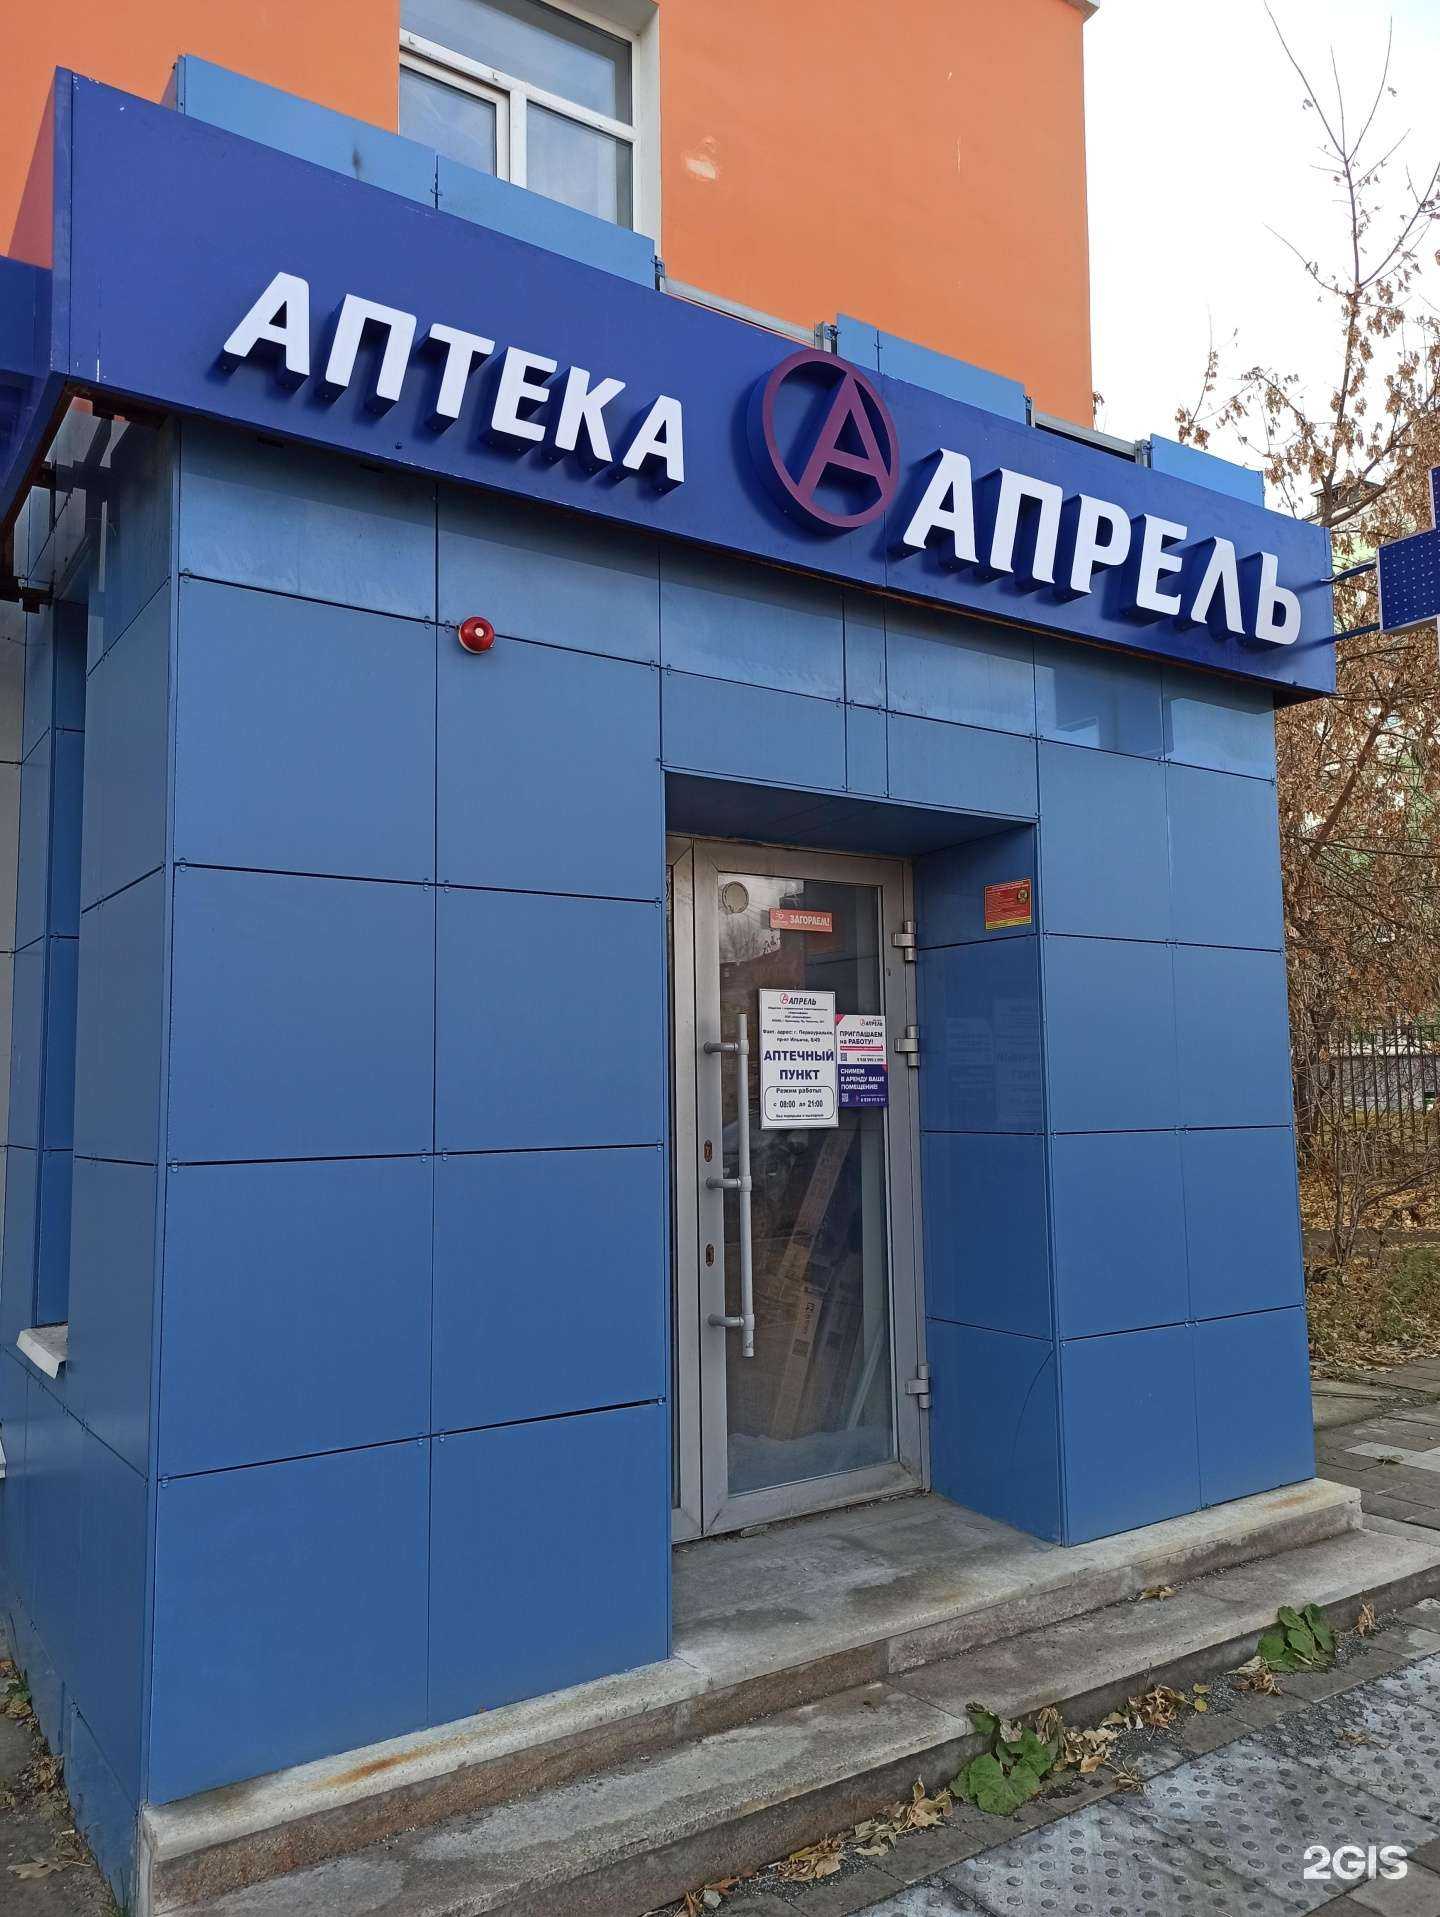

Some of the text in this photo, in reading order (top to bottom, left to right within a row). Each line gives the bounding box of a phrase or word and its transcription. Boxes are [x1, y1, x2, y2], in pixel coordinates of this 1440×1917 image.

[223, 271, 685, 483] АПТЕКА
[903, 448, 1302, 645] АПРЕЛЬ
[788, 997, 817, 1006] АПРЕЛЬ
[763, 1049, 834, 1061] АПТЕЧНЫЙ
[779, 1069, 820, 1080] ПУНКТ
[807, 1100, 823, 1108] 21:00
